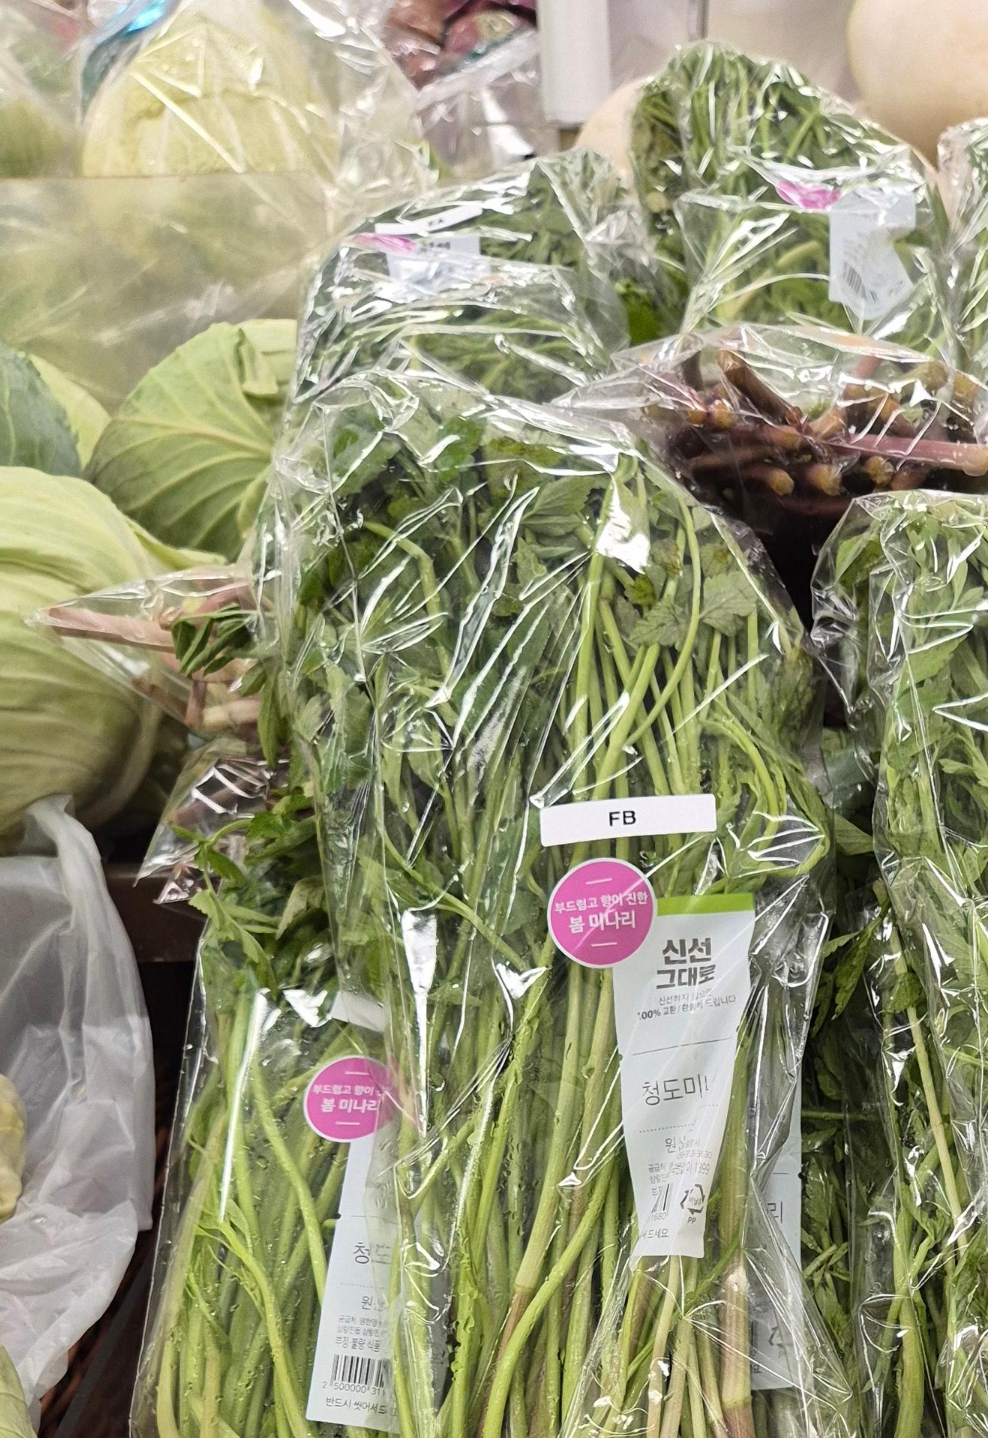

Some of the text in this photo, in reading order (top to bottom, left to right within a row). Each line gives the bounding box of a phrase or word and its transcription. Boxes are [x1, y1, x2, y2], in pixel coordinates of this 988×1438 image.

[609, 810, 637, 826] FB
[554, 896, 598, 914] 부드럽고
[627, 891, 648, 906] 진한
[569, 910, 636, 934] 봄 미나리
[663, 937, 712, 965] 신선
[656, 964, 716, 990] 그대로
[313, 1084, 351, 1095] 부드럽고
[354, 1085, 374, 1096] 향이
[321, 1098, 336, 1113] 봄
[687, 1216, 697, 1225] PP
[322, 1381, 328, 1390] 2
[334, 1382, 366, 1394] 500000
[326, 1397, 351, 1409] 반드시
